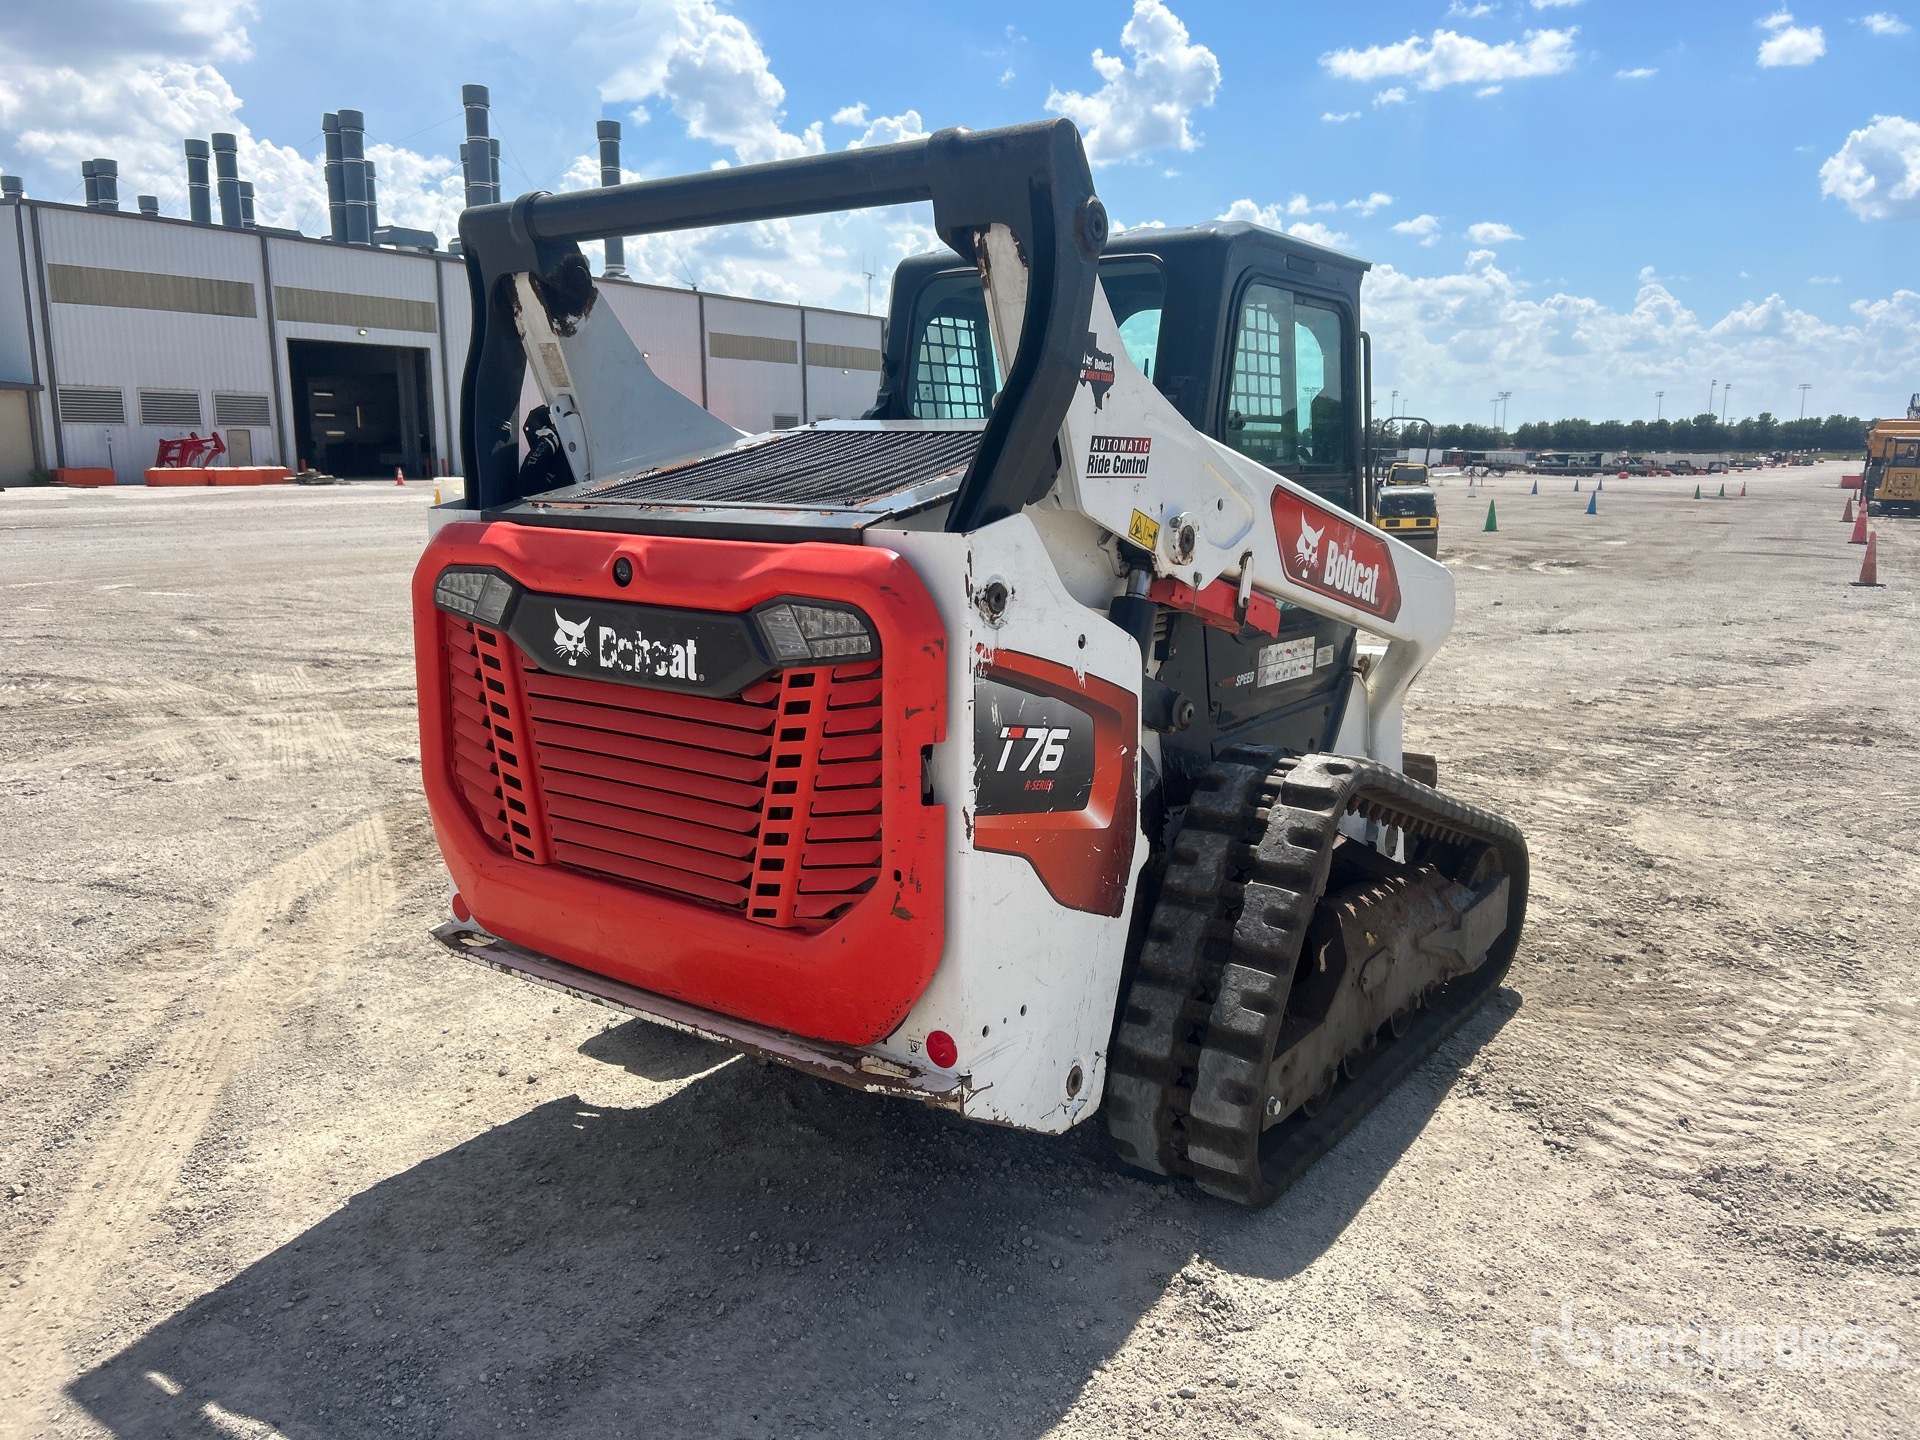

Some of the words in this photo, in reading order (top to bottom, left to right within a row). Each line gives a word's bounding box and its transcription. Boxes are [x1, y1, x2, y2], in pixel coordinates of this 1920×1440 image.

[1094, 358, 1112, 372] Bobcat
[1079, 369, 1086, 379] OF
[1092, 437, 1150, 452] AUTOMATIC
[1086, 454, 1110, 474] Ride
[1112, 455, 1150, 475] Control
[1323, 539, 1379, 605] Bobcat
[1235, 671, 1255, 687] SPEED
[996, 726, 1071, 773] T76
[1024, 779, 1055, 792] R-SERIES
